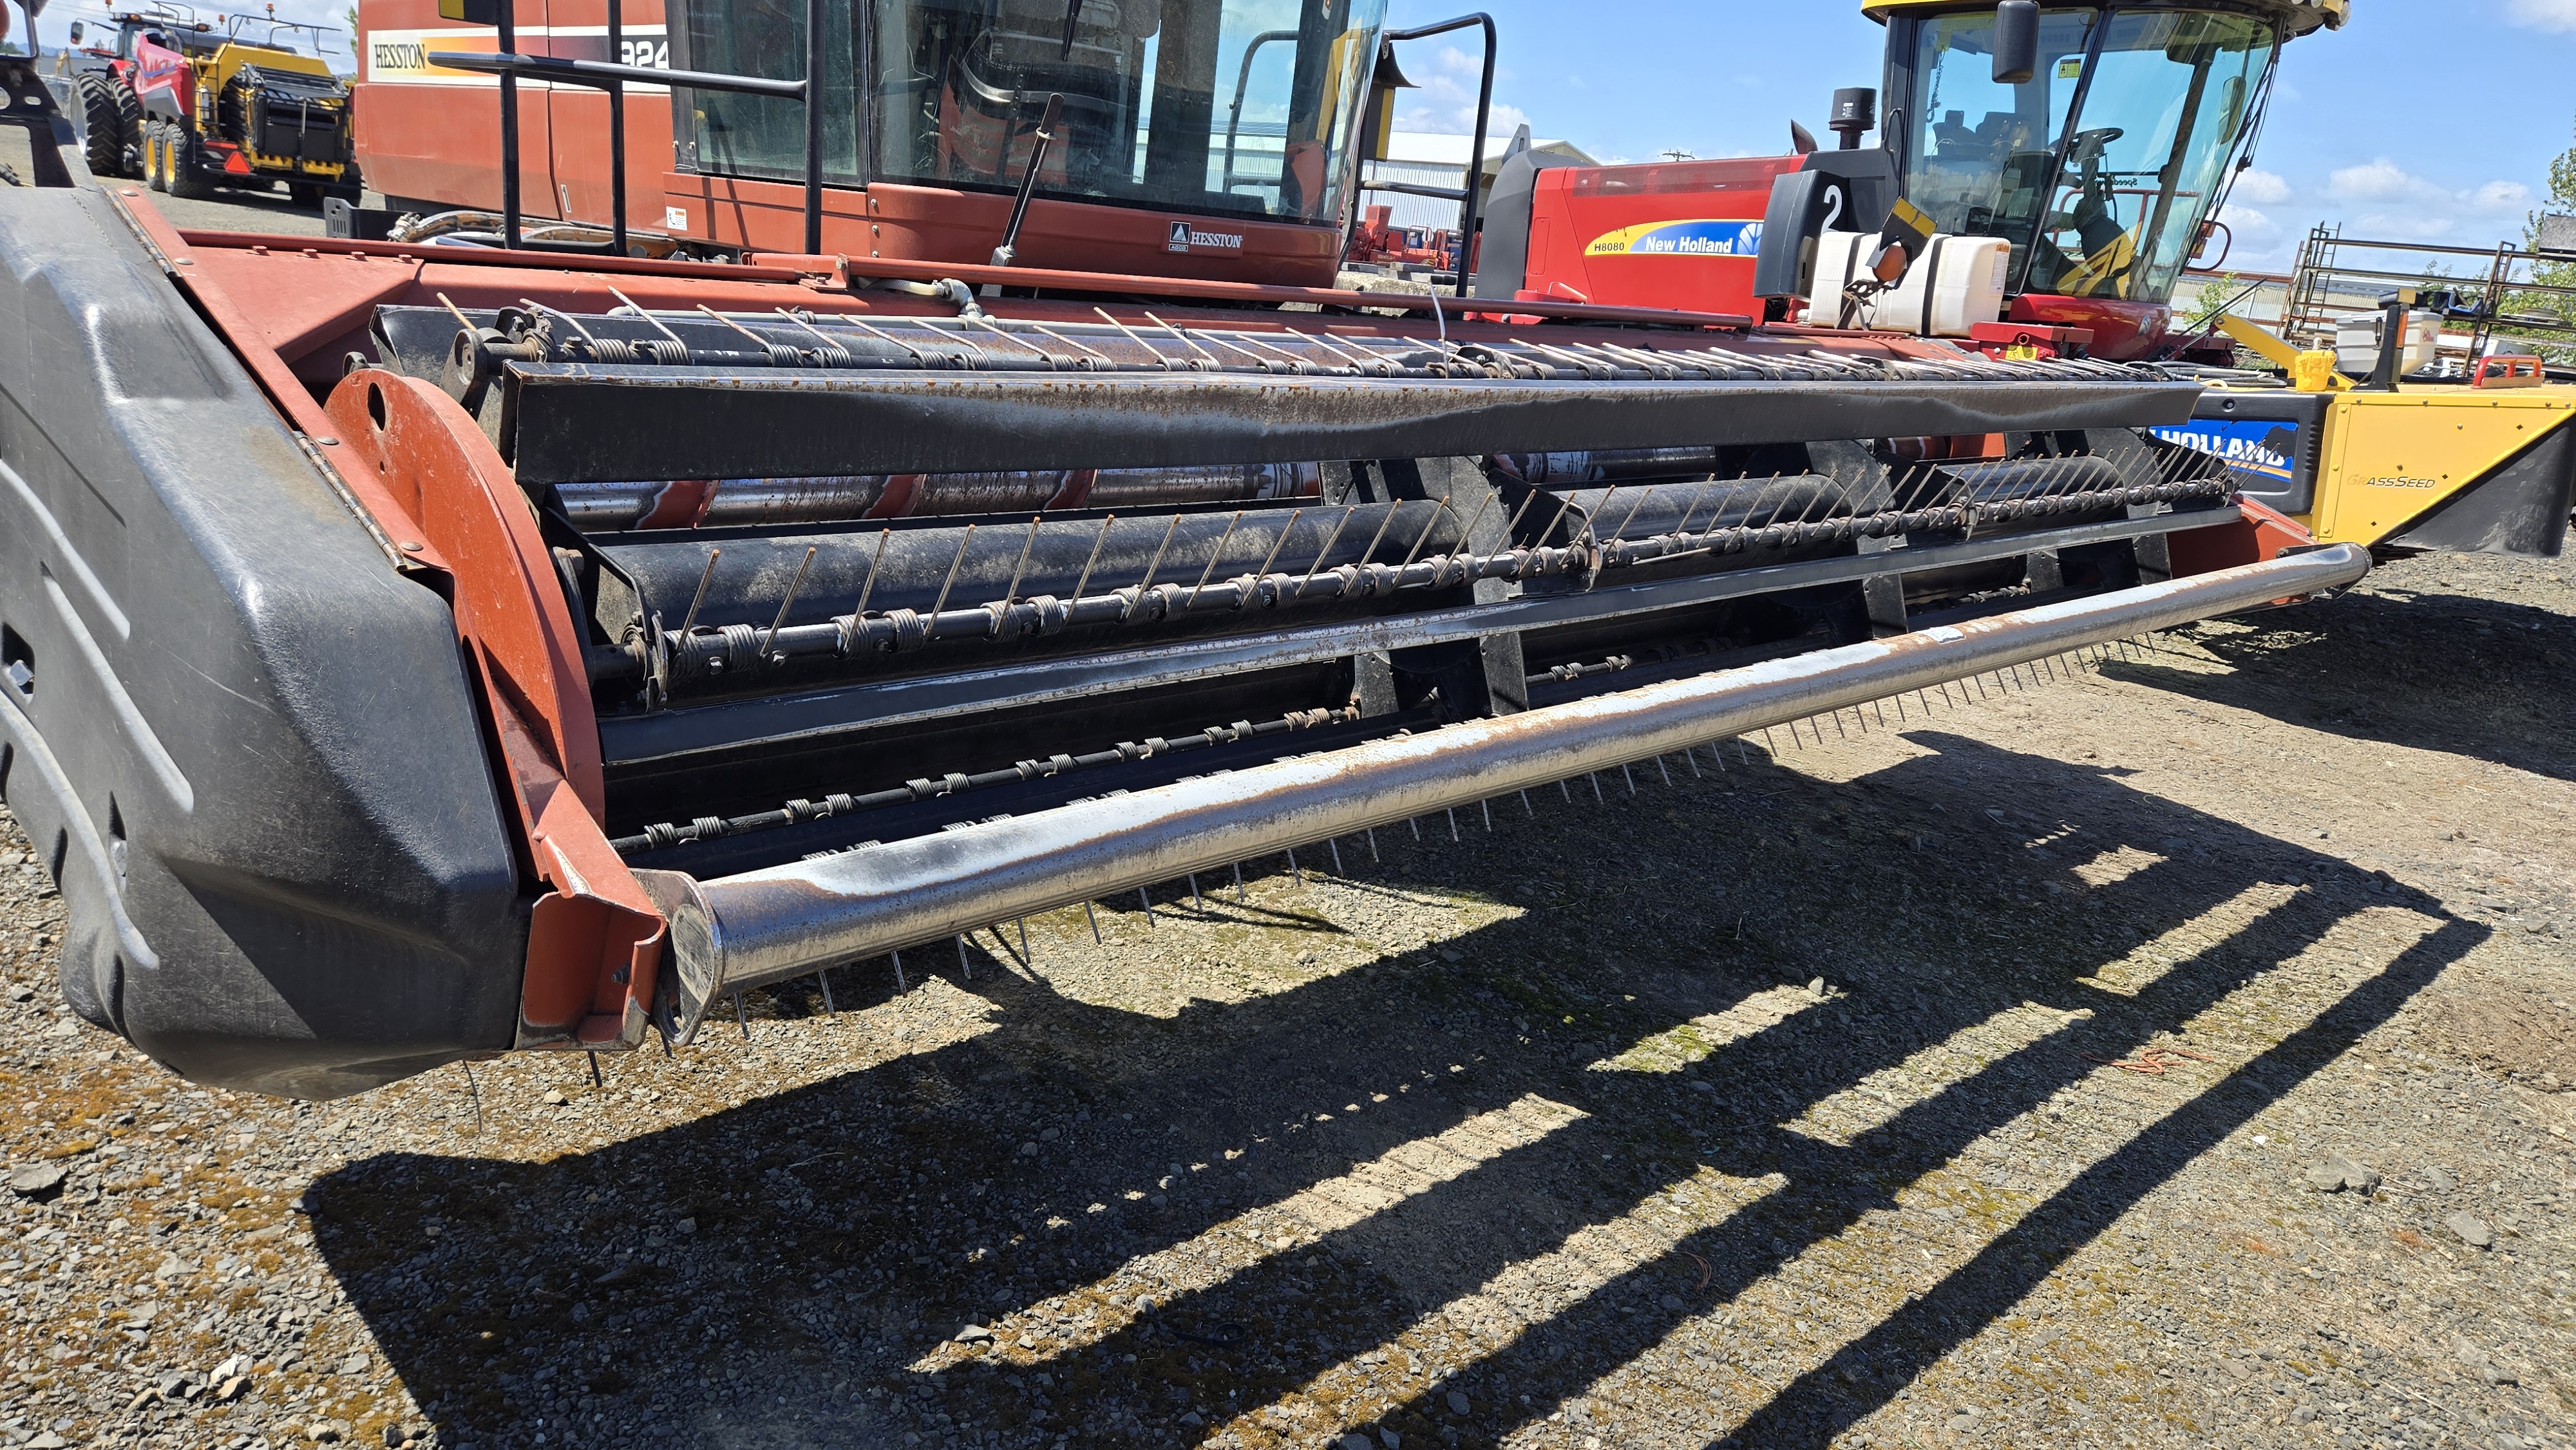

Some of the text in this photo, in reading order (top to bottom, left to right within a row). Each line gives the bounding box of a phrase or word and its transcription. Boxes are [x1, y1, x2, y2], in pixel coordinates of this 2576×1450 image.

[374, 43, 426, 69] HESSTON
[1821, 184, 1842, 236] 2
[1190, 231, 1242, 248] HESSTON
[1594, 242, 1625, 252] H8080
[1645, 236, 1733, 253] New Holland
